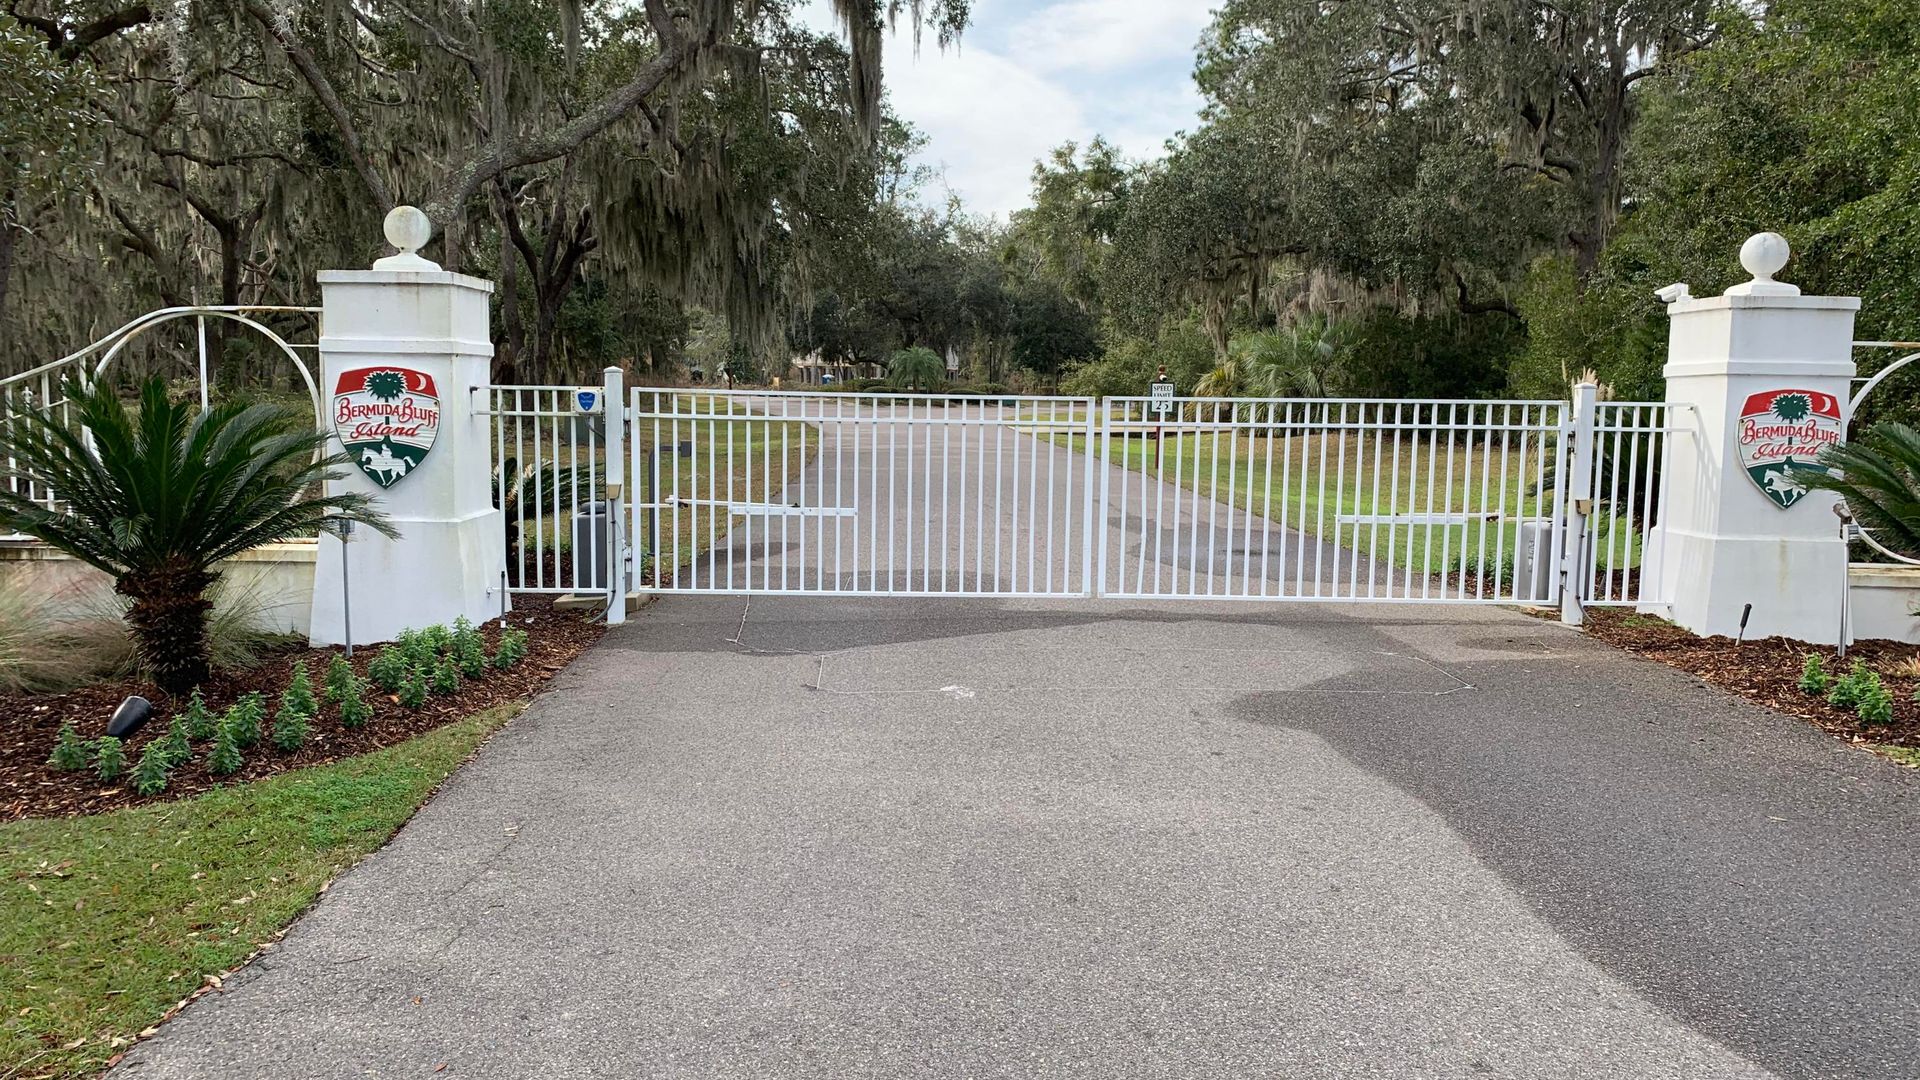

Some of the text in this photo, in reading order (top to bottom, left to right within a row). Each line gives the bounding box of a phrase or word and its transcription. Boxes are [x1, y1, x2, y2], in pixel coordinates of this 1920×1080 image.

[336, 397, 438, 428] BERMUDA BLUFF
[350, 422, 424, 439] Island
[1740, 419, 1803, 445] BERMUDA
[1752, 442, 1824, 460] Island
